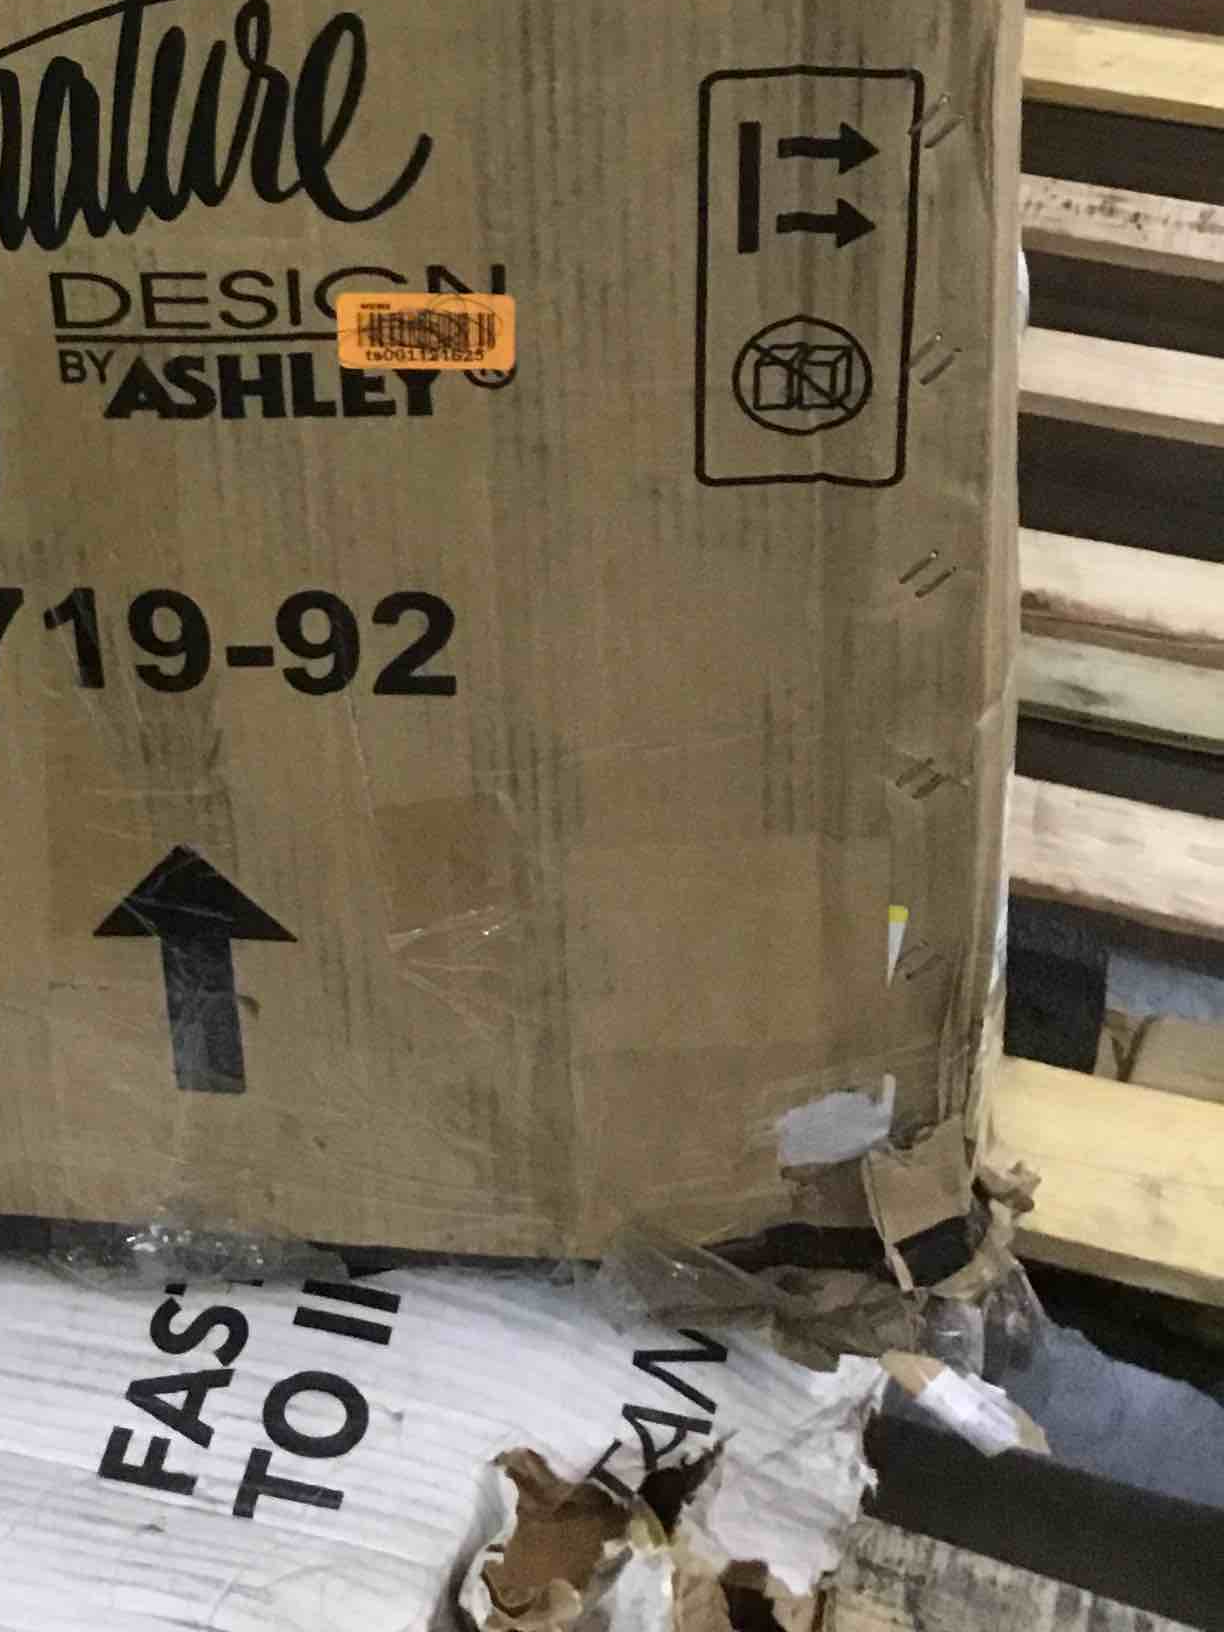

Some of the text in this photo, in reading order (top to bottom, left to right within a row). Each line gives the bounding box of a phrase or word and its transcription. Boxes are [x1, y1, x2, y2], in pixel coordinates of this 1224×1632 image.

[58, 349, 434, 420] BY ASHLEY
[98, 1279, 264, 1496] FAS
[232, 1370, 370, 1519] TO
